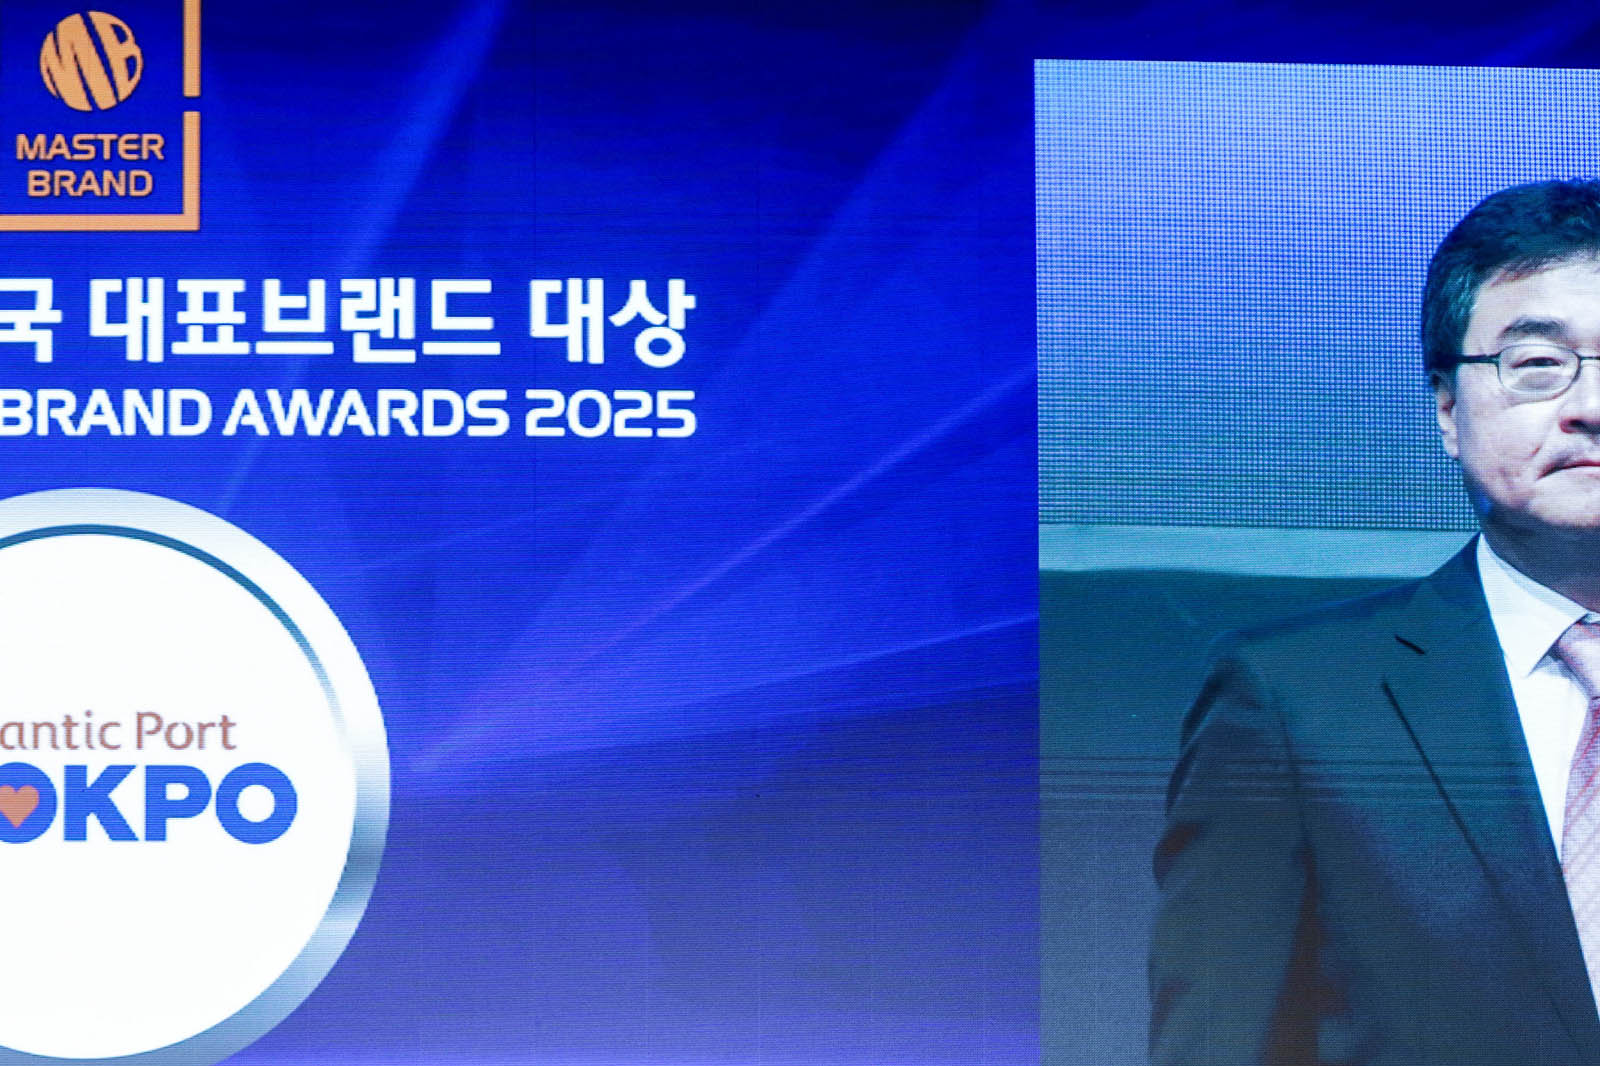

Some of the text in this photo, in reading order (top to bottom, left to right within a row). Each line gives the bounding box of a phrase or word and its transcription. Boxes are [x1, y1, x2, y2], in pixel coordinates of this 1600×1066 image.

[16, 133, 164, 160] MASTER
[27, 170, 153, 197] BRAND
[89, 277, 501, 363] 대표브랜드
[530, 277, 697, 368] 대상
[222, 388, 510, 437] AWARDS
[525, 389, 697, 438] 2025
[136, 711, 238, 751] Port
